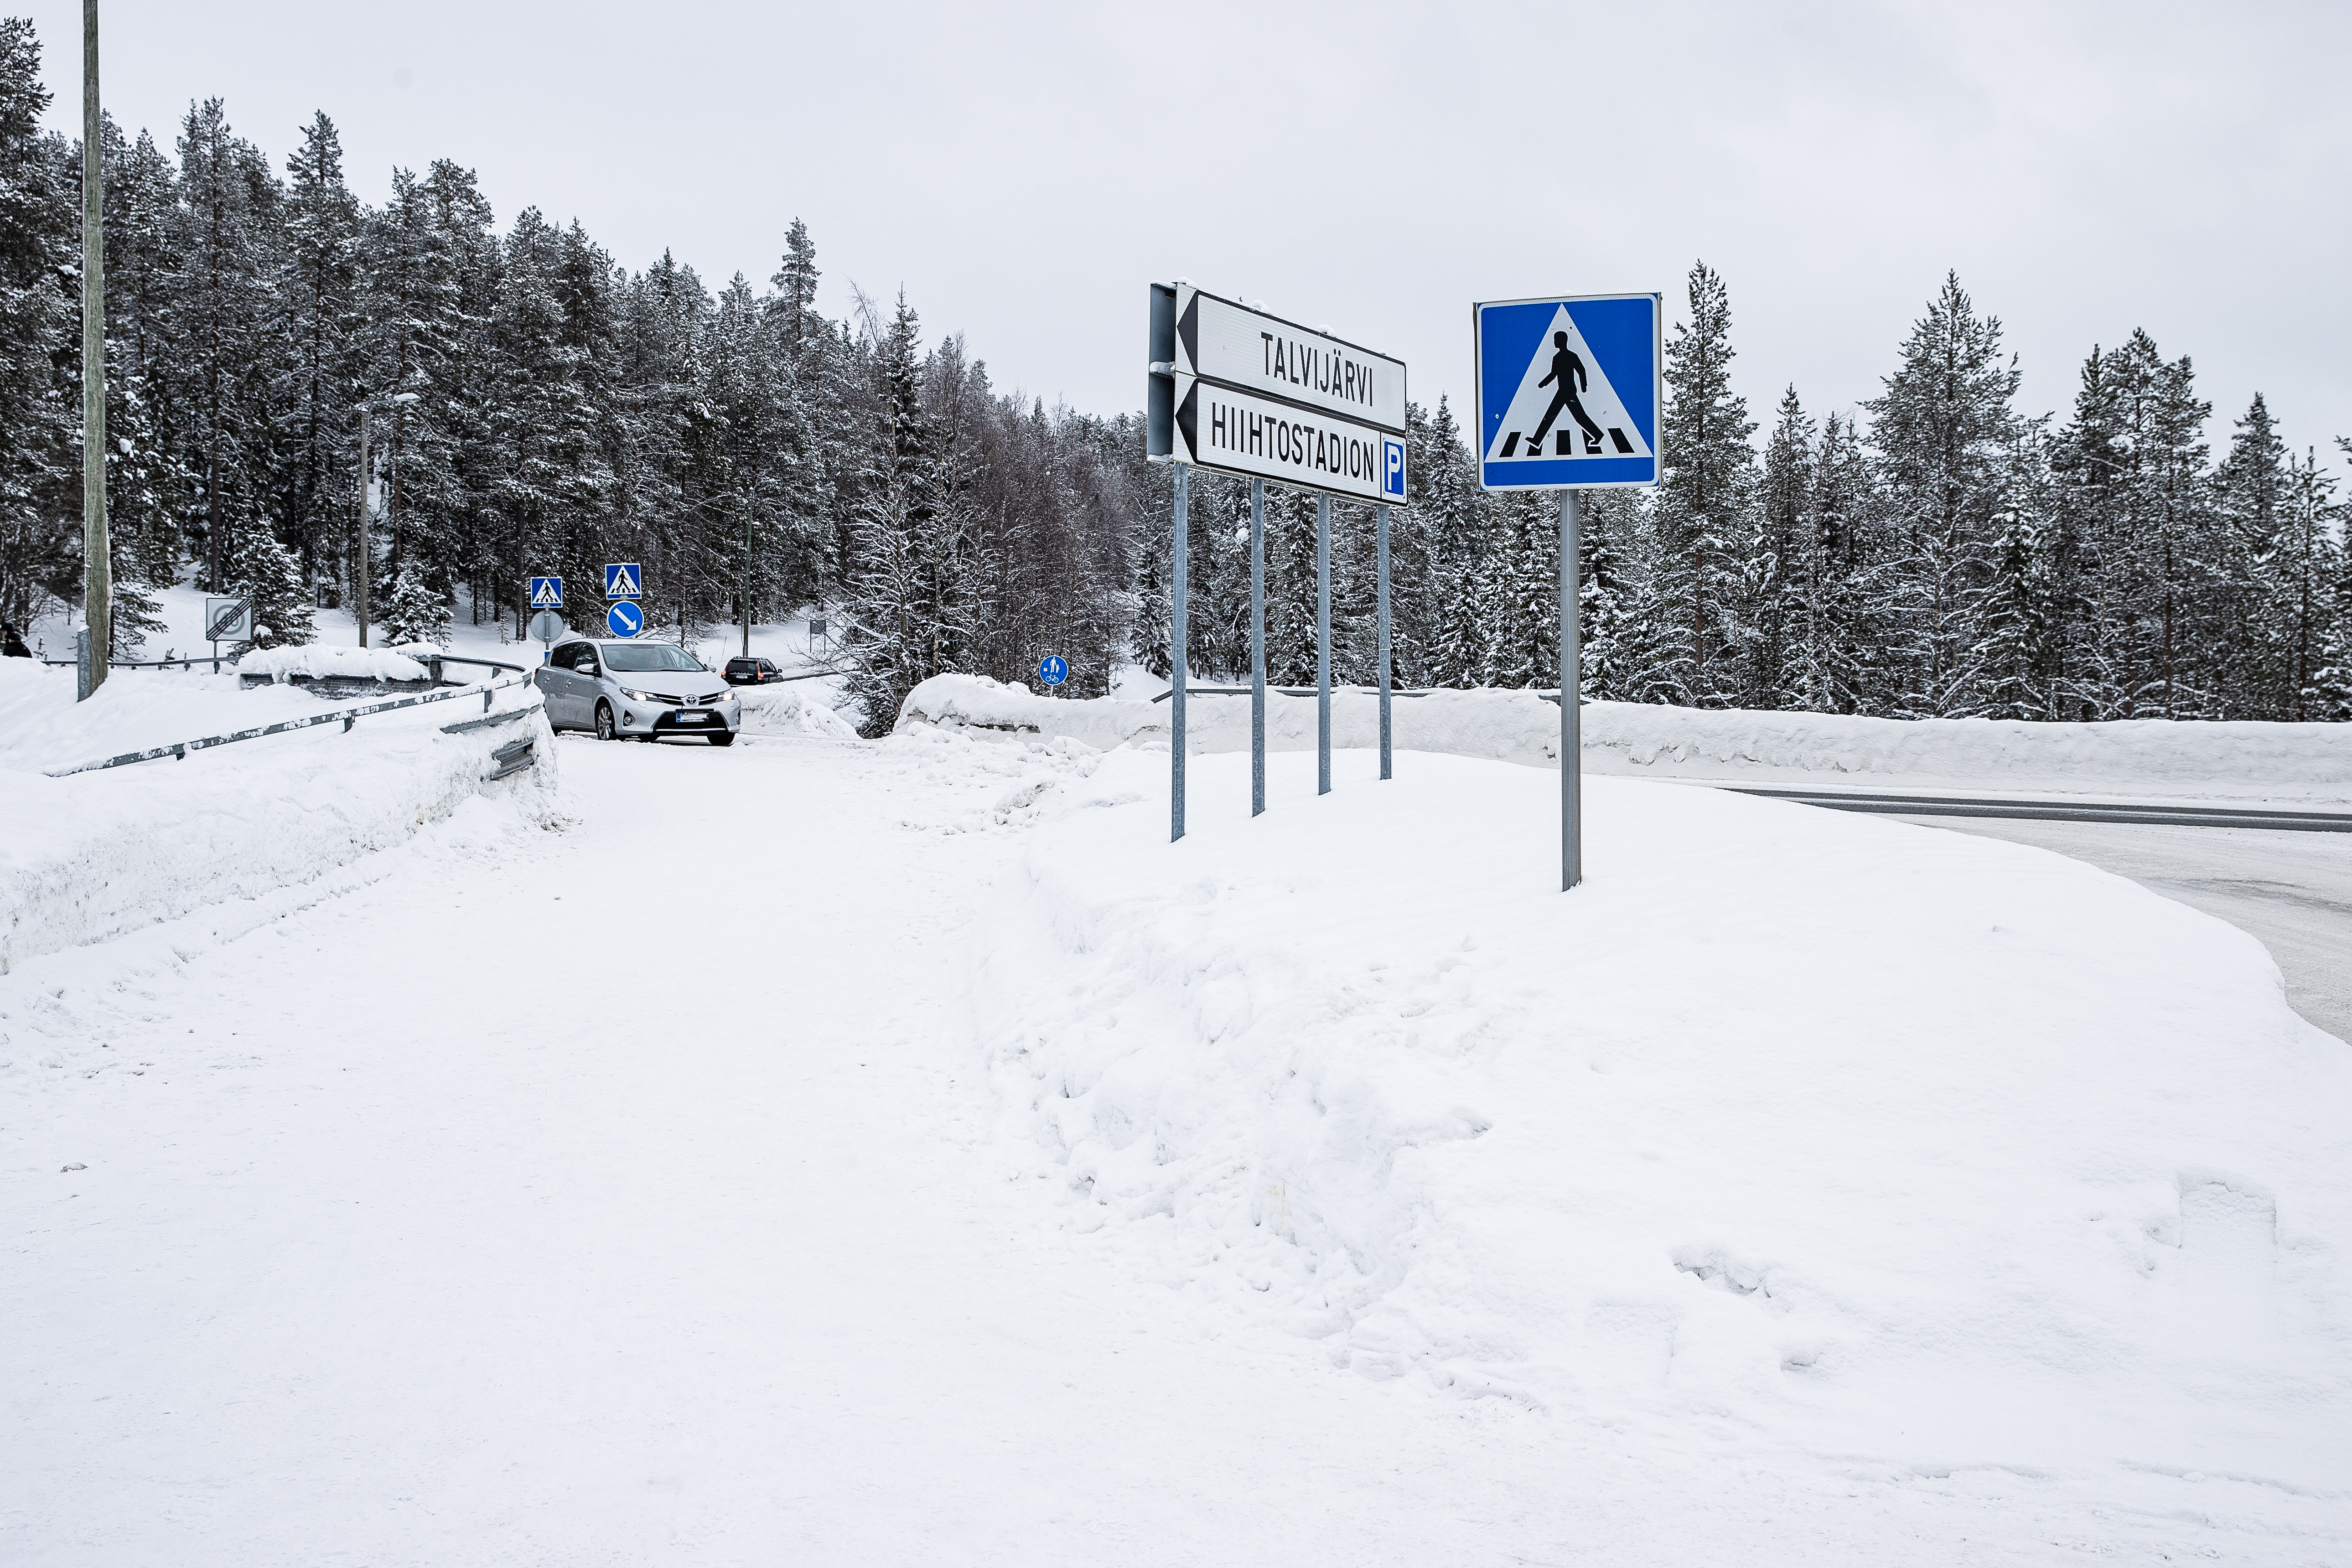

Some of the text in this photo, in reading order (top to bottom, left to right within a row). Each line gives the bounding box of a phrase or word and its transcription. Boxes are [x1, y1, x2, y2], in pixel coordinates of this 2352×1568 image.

[1261, 332, 1373, 406] TALVIJÄRVI
[1212, 402, 1373, 482] HIIHTOSTADION
[1388, 445, 1401, 490] P
